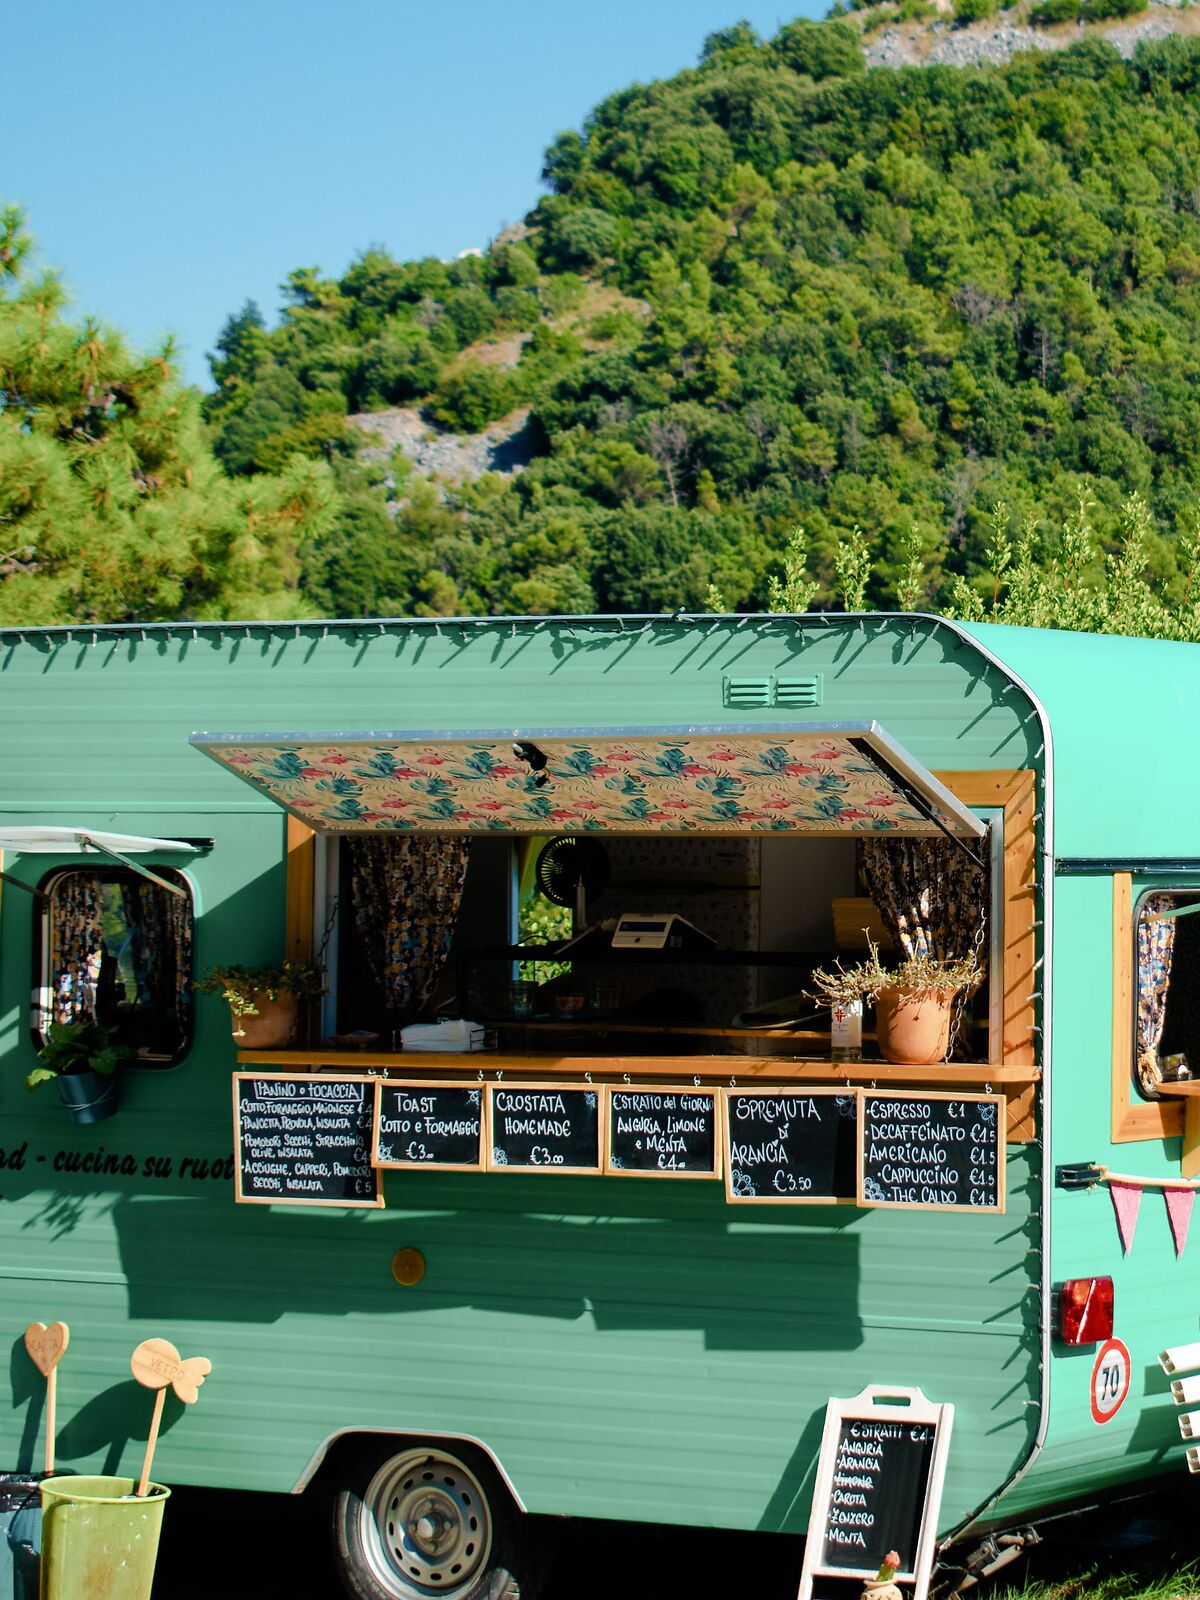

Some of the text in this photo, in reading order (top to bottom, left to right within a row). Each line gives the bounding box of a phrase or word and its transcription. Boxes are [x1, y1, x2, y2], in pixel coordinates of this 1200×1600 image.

[393, 1093, 437, 1113] TOAST
[496, 1092, 565, 1114] CROSTATA
[613, 1094, 662, 1112] ESTRATTO
[736, 1097, 821, 1122] SPREMUTA
[870, 1101, 931, 1120] ESPRESSO
[505, 1117, 571, 1136] HOMEMADE
[667, 1114, 705, 1133] LIMONE
[870, 1121, 965, 1141] DECAFFEINATO
[646, 1134, 687, 1153] MENTA
[731, 1140, 789, 1166] ARANCIA
[869, 1142, 946, 1163] AMERICANO
[53, 1146, 138, 1176] cucina
[142, 1157, 172, 1178] su
[179, 1153, 235, 1179] ruot
[881, 1164, 958, 1184] CAPPUCCINO
[921, 1186, 957, 1204] CALDO
[1101, 1364, 1119, 1401] 70
[842, 1438, 883, 1456] ANGURIA
[839, 1456, 880, 1471] ARANCIA
[833, 1492, 867, 1507] CAROTA
[829, 1529, 866, 1547] MENTA
